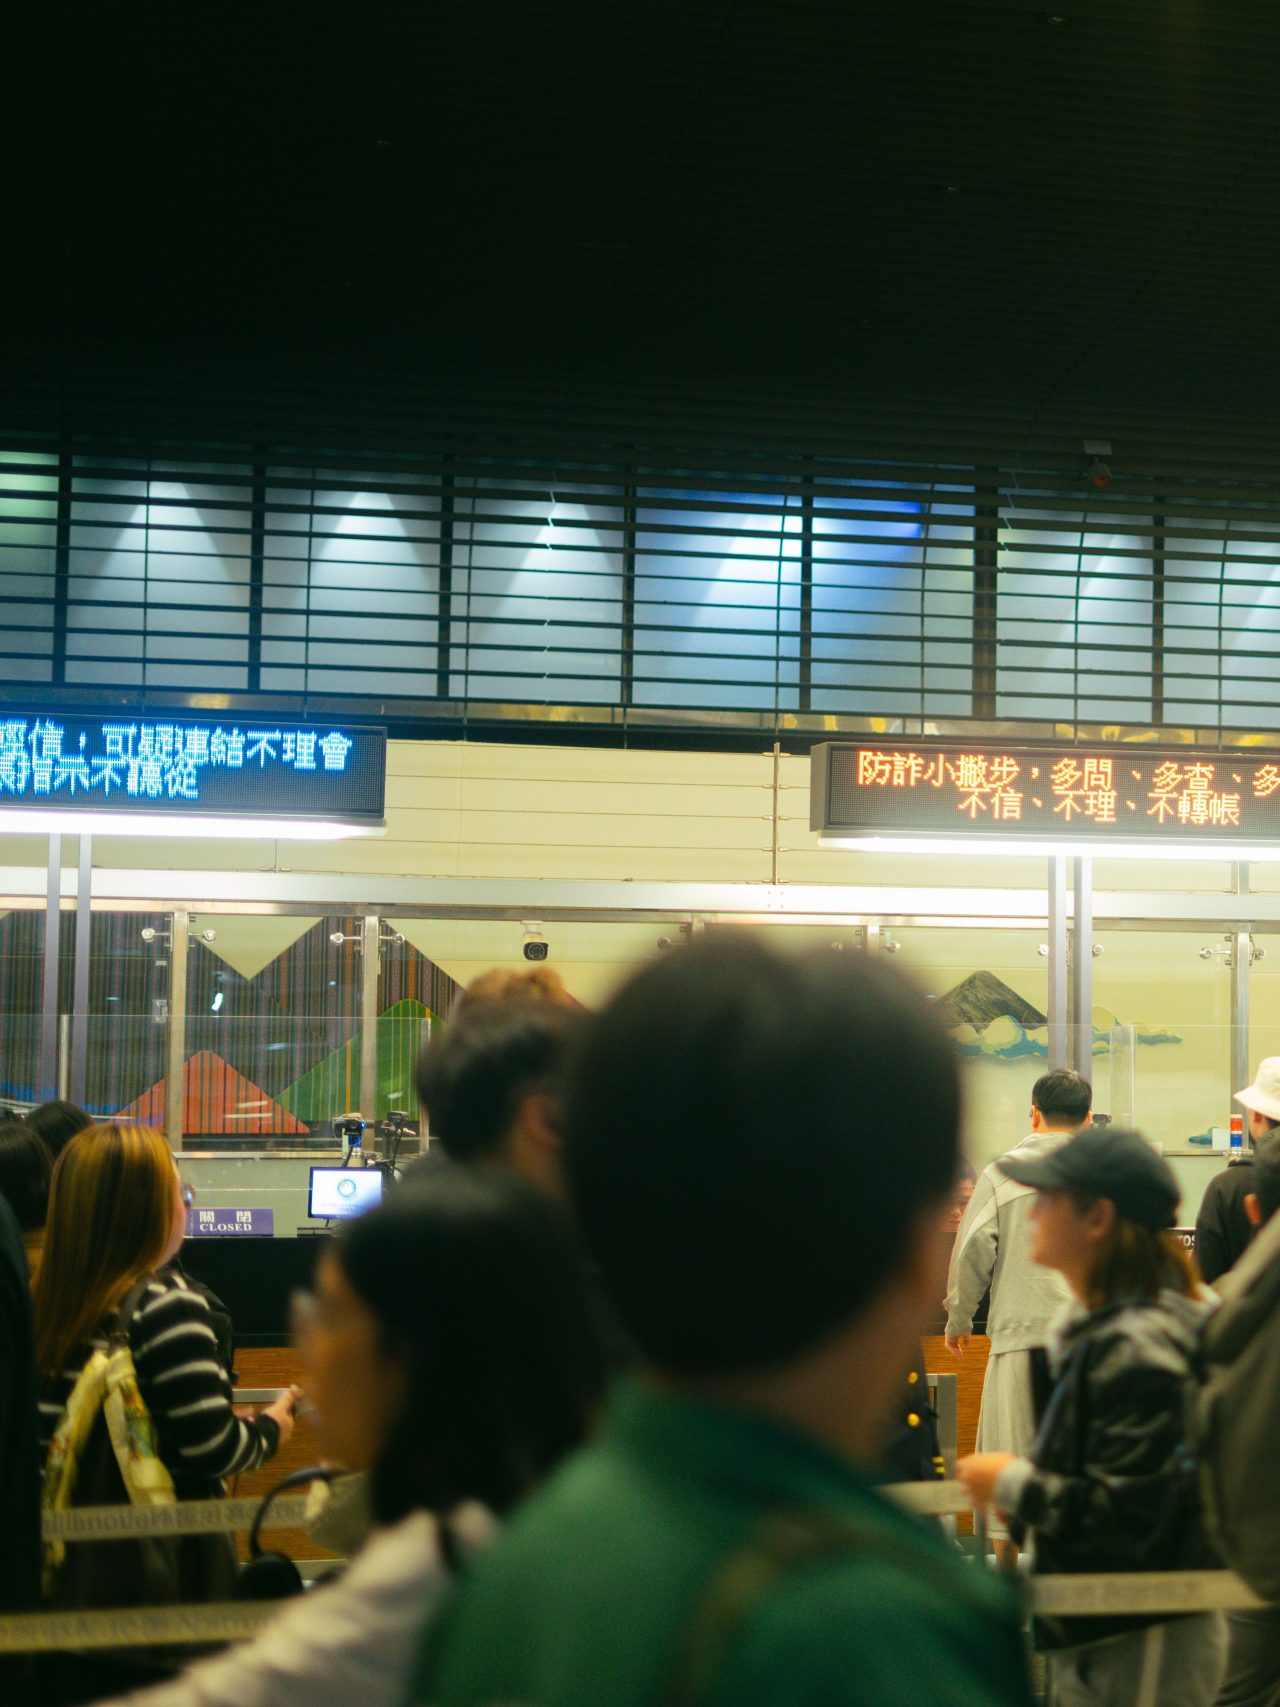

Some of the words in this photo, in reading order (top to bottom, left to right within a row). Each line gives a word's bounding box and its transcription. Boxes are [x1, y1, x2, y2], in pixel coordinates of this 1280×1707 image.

[957, 786, 1241, 826] 不信、不理、不轉帳
[199, 1223, 252, 1232] CLOSED
